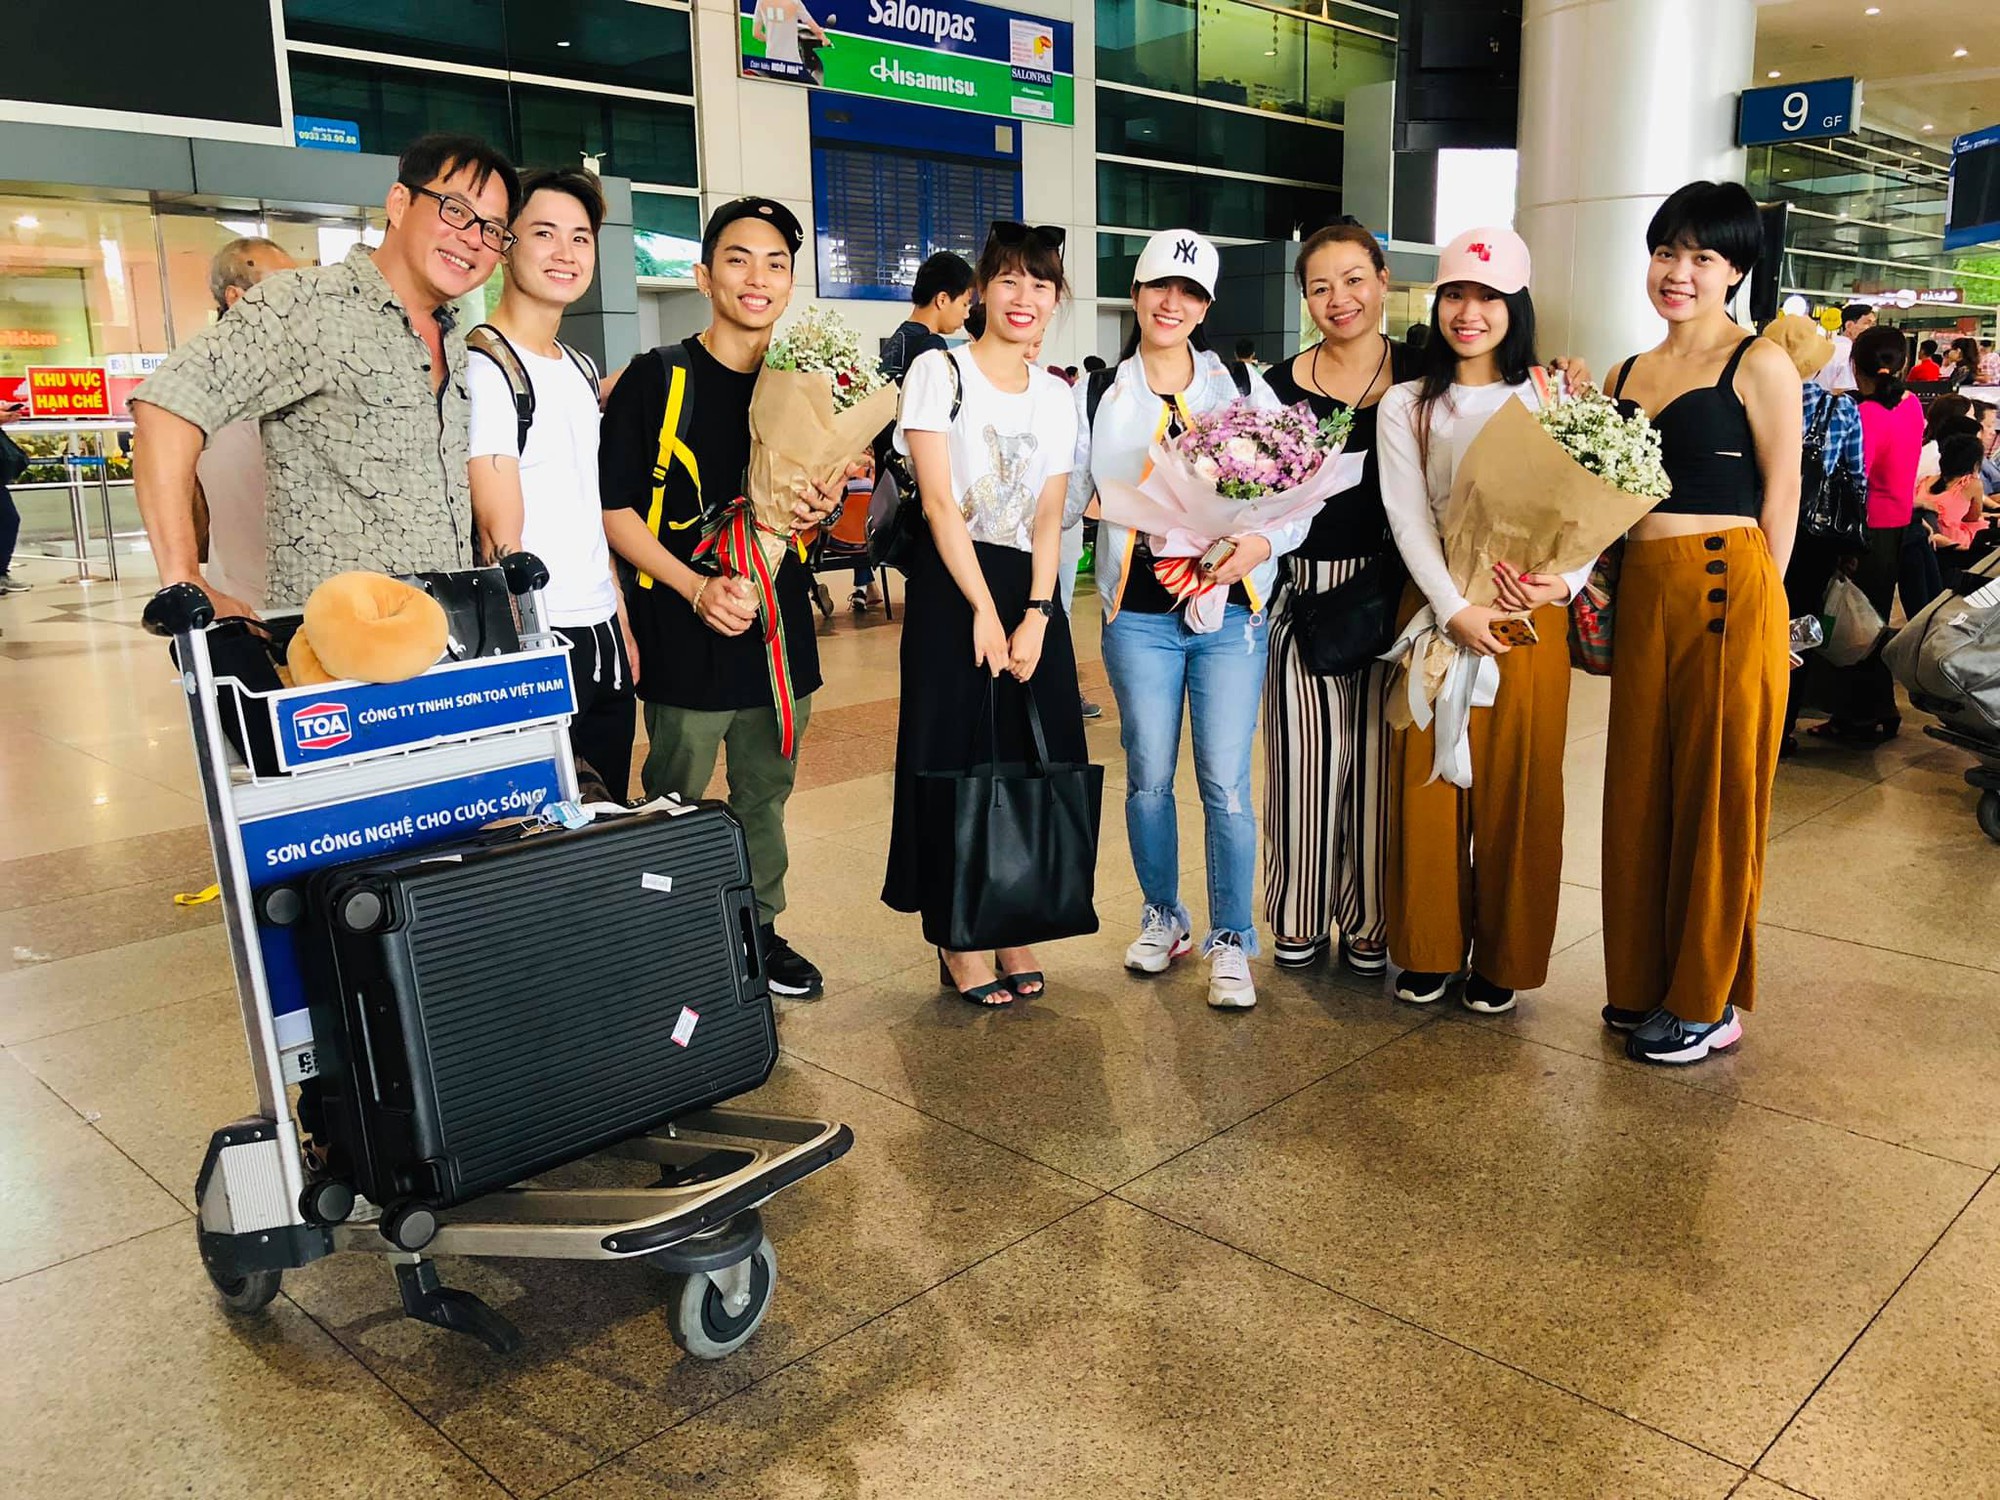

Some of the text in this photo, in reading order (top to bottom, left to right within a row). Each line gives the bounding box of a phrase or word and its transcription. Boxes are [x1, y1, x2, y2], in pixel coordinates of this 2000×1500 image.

[868, 0, 975, 43] Salonpas
[869, 57, 975, 97] Hisamitsu
[1012, 67, 1052, 84] SALONPAS
[1782, 91, 1809, 132] 9
[1822, 115, 1843, 128] GF
[1173, 238, 1198, 265] NY
[34, 371, 101, 391] KHU VỰC
[36, 388, 103, 413] HẠN CHẾ
[358, 707, 398, 725] CÔNG
[398, 703, 416, 718] TY
[416, 697, 454, 715] TNHH
[456, 692, 482, 707] SƠN
[509, 681, 535, 699] VIỆT
[536, 678, 564, 694] NAM
[297, 714, 347, 739] TOA
[265, 788, 543, 867] SƠN CÔNG NGHỆ CHO CUỘC SỐNG
